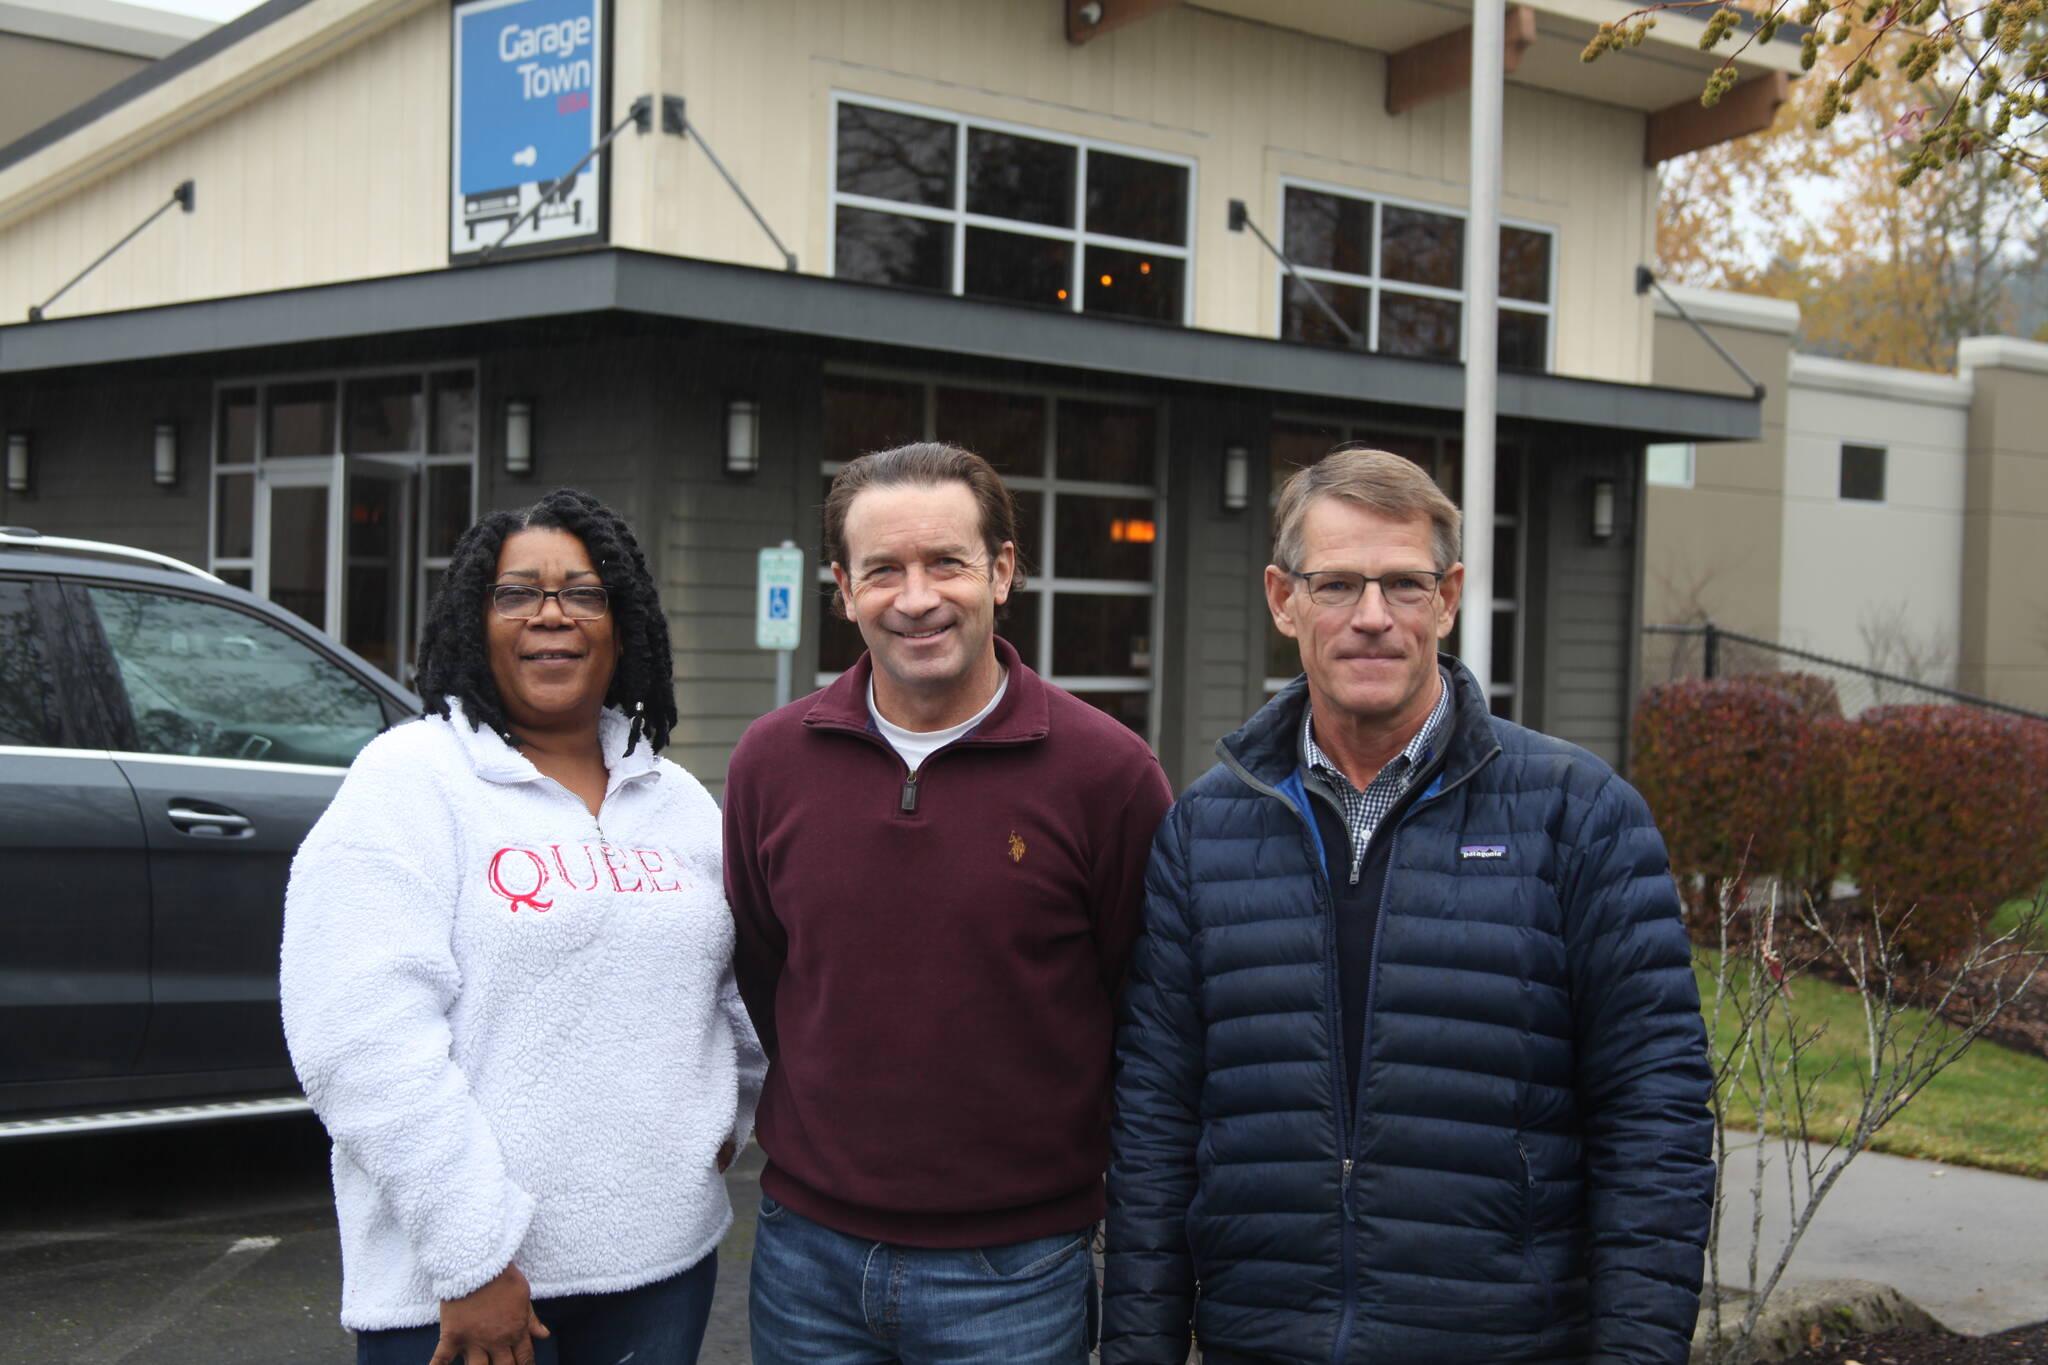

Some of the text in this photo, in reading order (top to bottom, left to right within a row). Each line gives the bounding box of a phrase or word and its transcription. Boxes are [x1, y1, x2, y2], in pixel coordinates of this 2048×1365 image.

[499, 16, 591, 62] Garage
[516, 59, 591, 99] Town
[488, 844, 693, 912] QUEE
